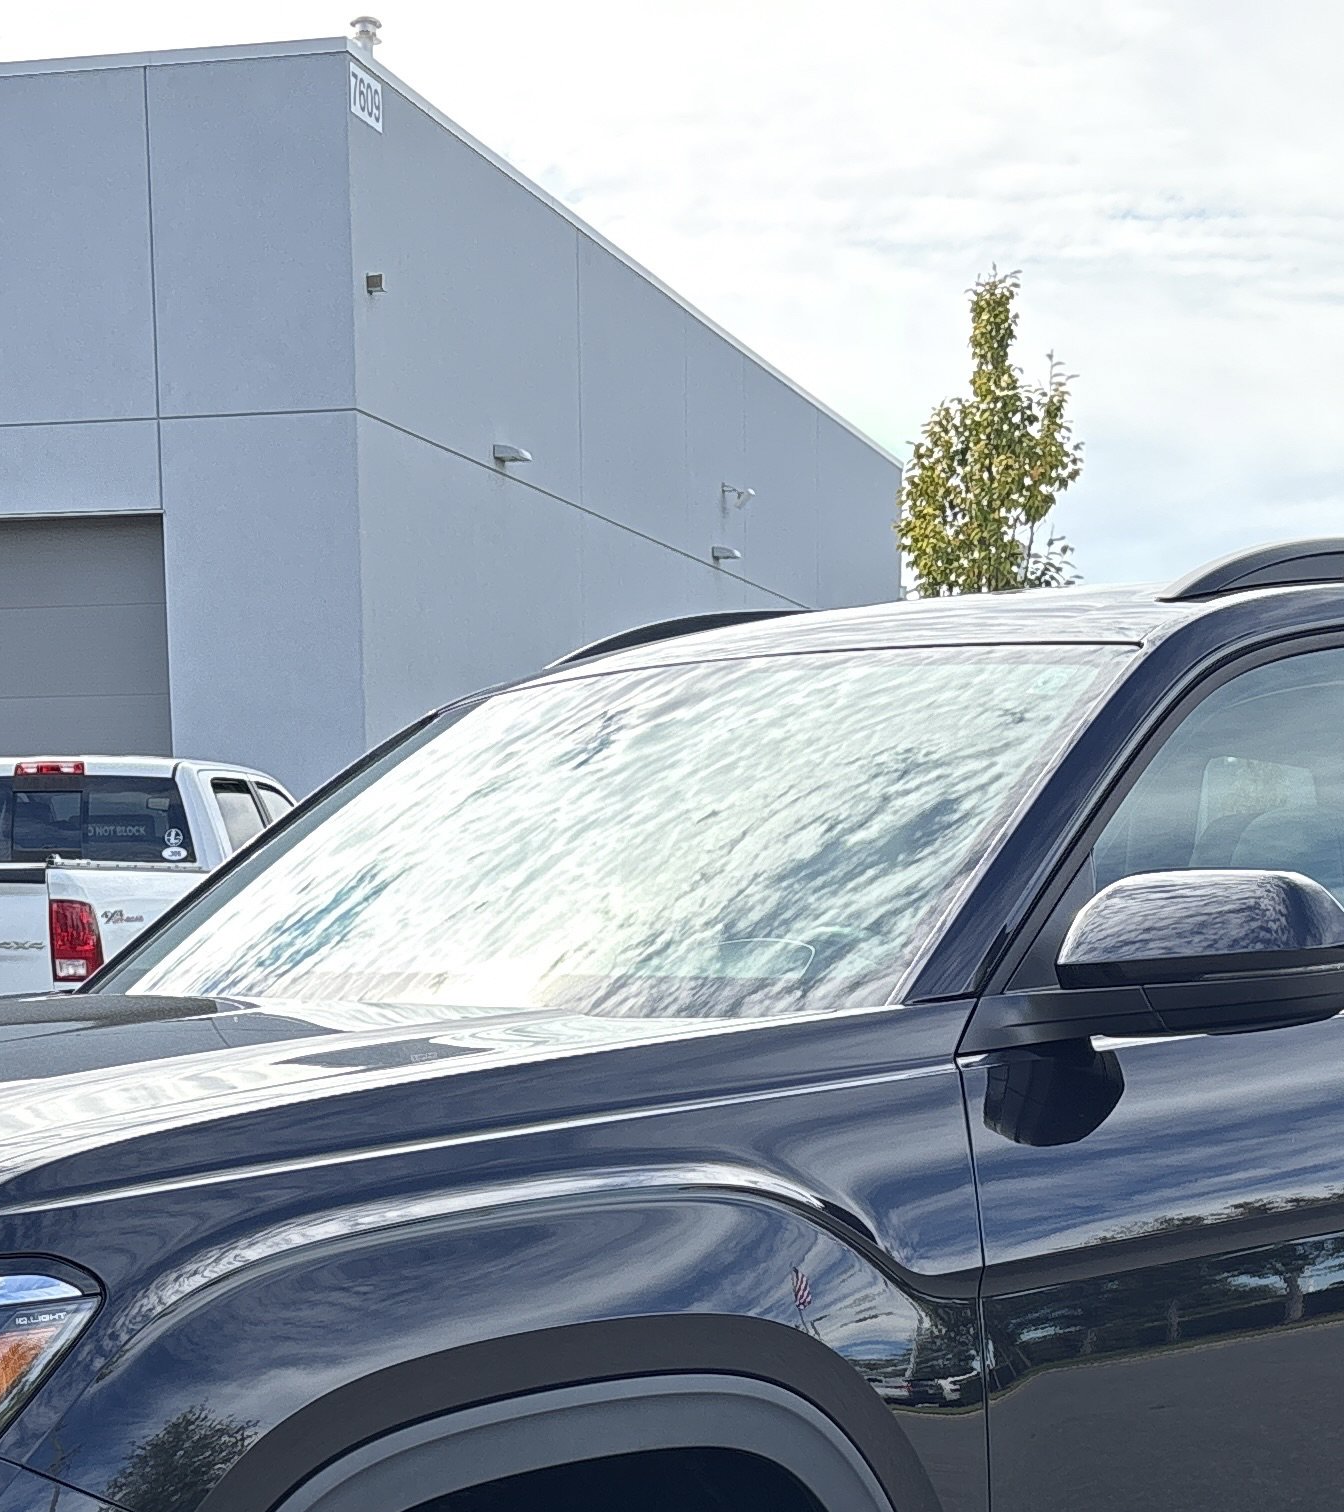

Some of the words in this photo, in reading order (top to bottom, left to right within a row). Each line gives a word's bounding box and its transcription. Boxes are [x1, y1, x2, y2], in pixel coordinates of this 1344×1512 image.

[351, 71, 381, 124] 7609
[95, 825, 116, 836] NOT
[116, 825, 146, 836] BLOCK
